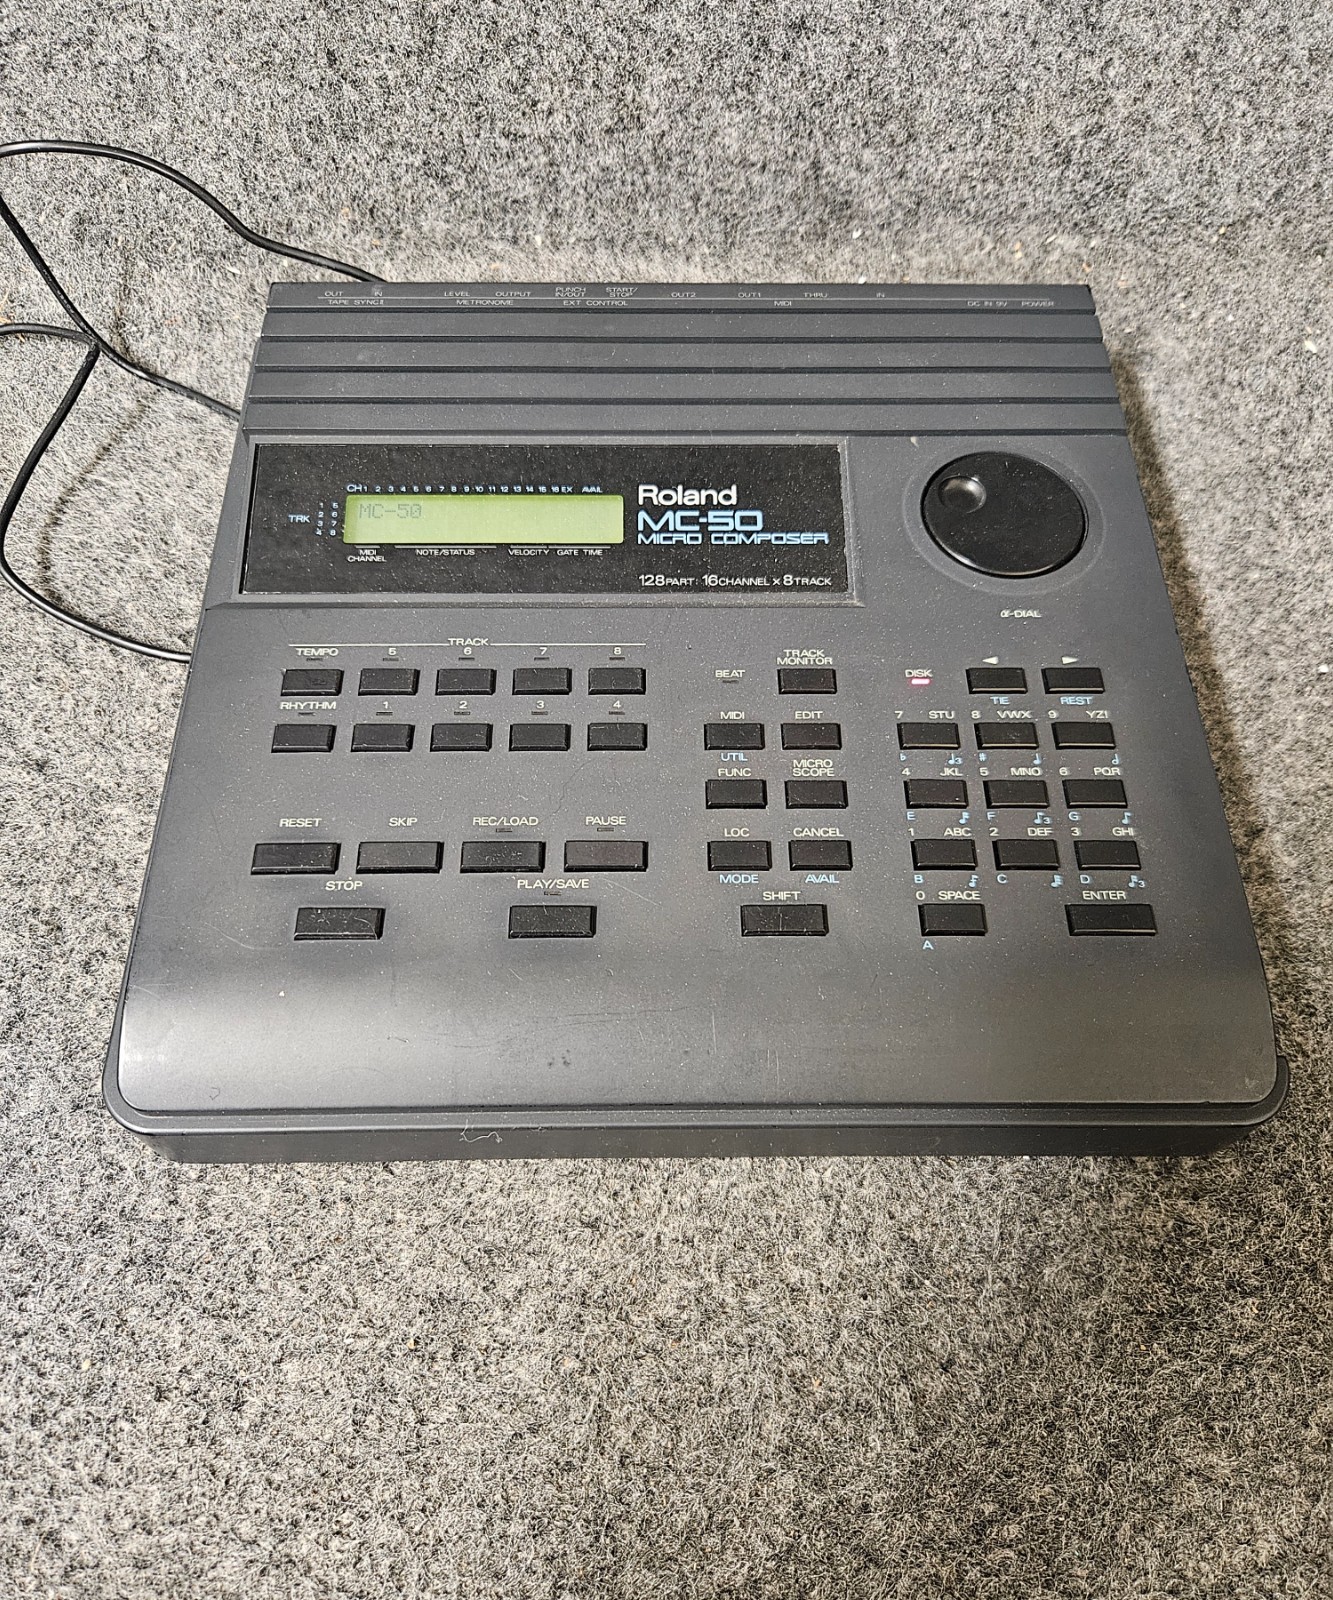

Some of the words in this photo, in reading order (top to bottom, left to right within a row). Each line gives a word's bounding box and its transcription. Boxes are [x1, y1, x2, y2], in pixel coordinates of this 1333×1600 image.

[346, 484, 362, 493] CH
[638, 484, 738, 506] Roland
[359, 503, 422, 519] MC-50
[288, 514, 311, 524] TRK
[637, 509, 764, 532] MC-50
[637, 532, 703, 545] MICRO
[710, 532, 830, 545] COMPOSER
[415, 549, 476, 557] NOTE/STATUS
[508, 549, 550, 557] VELOCITY
[556, 549, 579, 557] GATE
[583, 549, 604, 557] TIME
[347, 555, 387, 563] CHANNEL
[701, 574, 770, 587] 16CHANNEL
[448, 637, 490, 647] TRACK
[296, 647, 339, 657] TEMPO
[388, 647, 397, 657] 5
[463, 646, 473, 657] 6
[539, 646, 548, 657] 7
[613, 646, 623, 657] 8
[783, 649, 825, 658] TRACK
[776, 657, 833, 665] MONITOR
[715, 669, 745, 678] BEAT
[905, 668, 933, 679] DISK
[280, 701, 337, 711] RHYTHM
[383, 700, 389, 711] 1
[458, 700, 468, 710] 2
[535, 699, 545, 710] 3
[611, 699, 622, 710] 4
[990, 696, 1011, 706] TIE
[1060, 696, 1094, 706] REST
[720, 711, 745, 720] MIDI
[795, 710, 824, 720] EDIT
[894, 711, 903, 719] 7
[928, 711, 956, 719] STU
[971, 711, 981, 719] 8
[997, 711, 1032, 719] VWX
[1048, 711, 1058, 719] 9
[720, 752, 748, 762] UTIL
[792, 759, 833, 768] MICRO
[717, 768, 752, 777] FUNC
[792, 767, 835, 777] SCOPE
[901, 768, 911, 776] 4
[939, 768, 963, 777] JKL
[979, 768, 990, 776] 5
[1010, 768, 1042, 777] MNO
[1058, 767, 1068, 776] 6
[1093, 767, 1121, 776] PQR
[585, 815, 627, 826] PAUSE
[906, 811, 916, 820] E
[986, 811, 996, 820] F
[1068, 811, 1080, 821] G
[279, 817, 322, 828] RESET
[388, 816, 418, 828] SKIP
[472, 815, 539, 827] REC/LOAD
[724, 827, 750, 837] LOC
[793, 827, 844, 837] CANCEL
[908, 827, 915, 836] 1
[943, 827, 972, 837] ABC
[989, 827, 999, 836] 2
[1027, 827, 1053, 837] DEF
[1071, 827, 1080, 836] 3
[1112, 827, 1135, 837] GHI
[719, 874, 759, 884] MODE
[804, 874, 840, 884] AVAIL
[914, 874, 924, 884] B
[997, 874, 1008, 884] C
[1080, 874, 1091, 884] D
[325, 880, 363, 891] STOP
[517, 879, 589, 890] PLAY/SAVE
[762, 891, 801, 901] SHIFT
[938, 890, 981, 900] SPACE
[1082, 890, 1127, 900] ENTER
[922, 940, 934, 950] A
